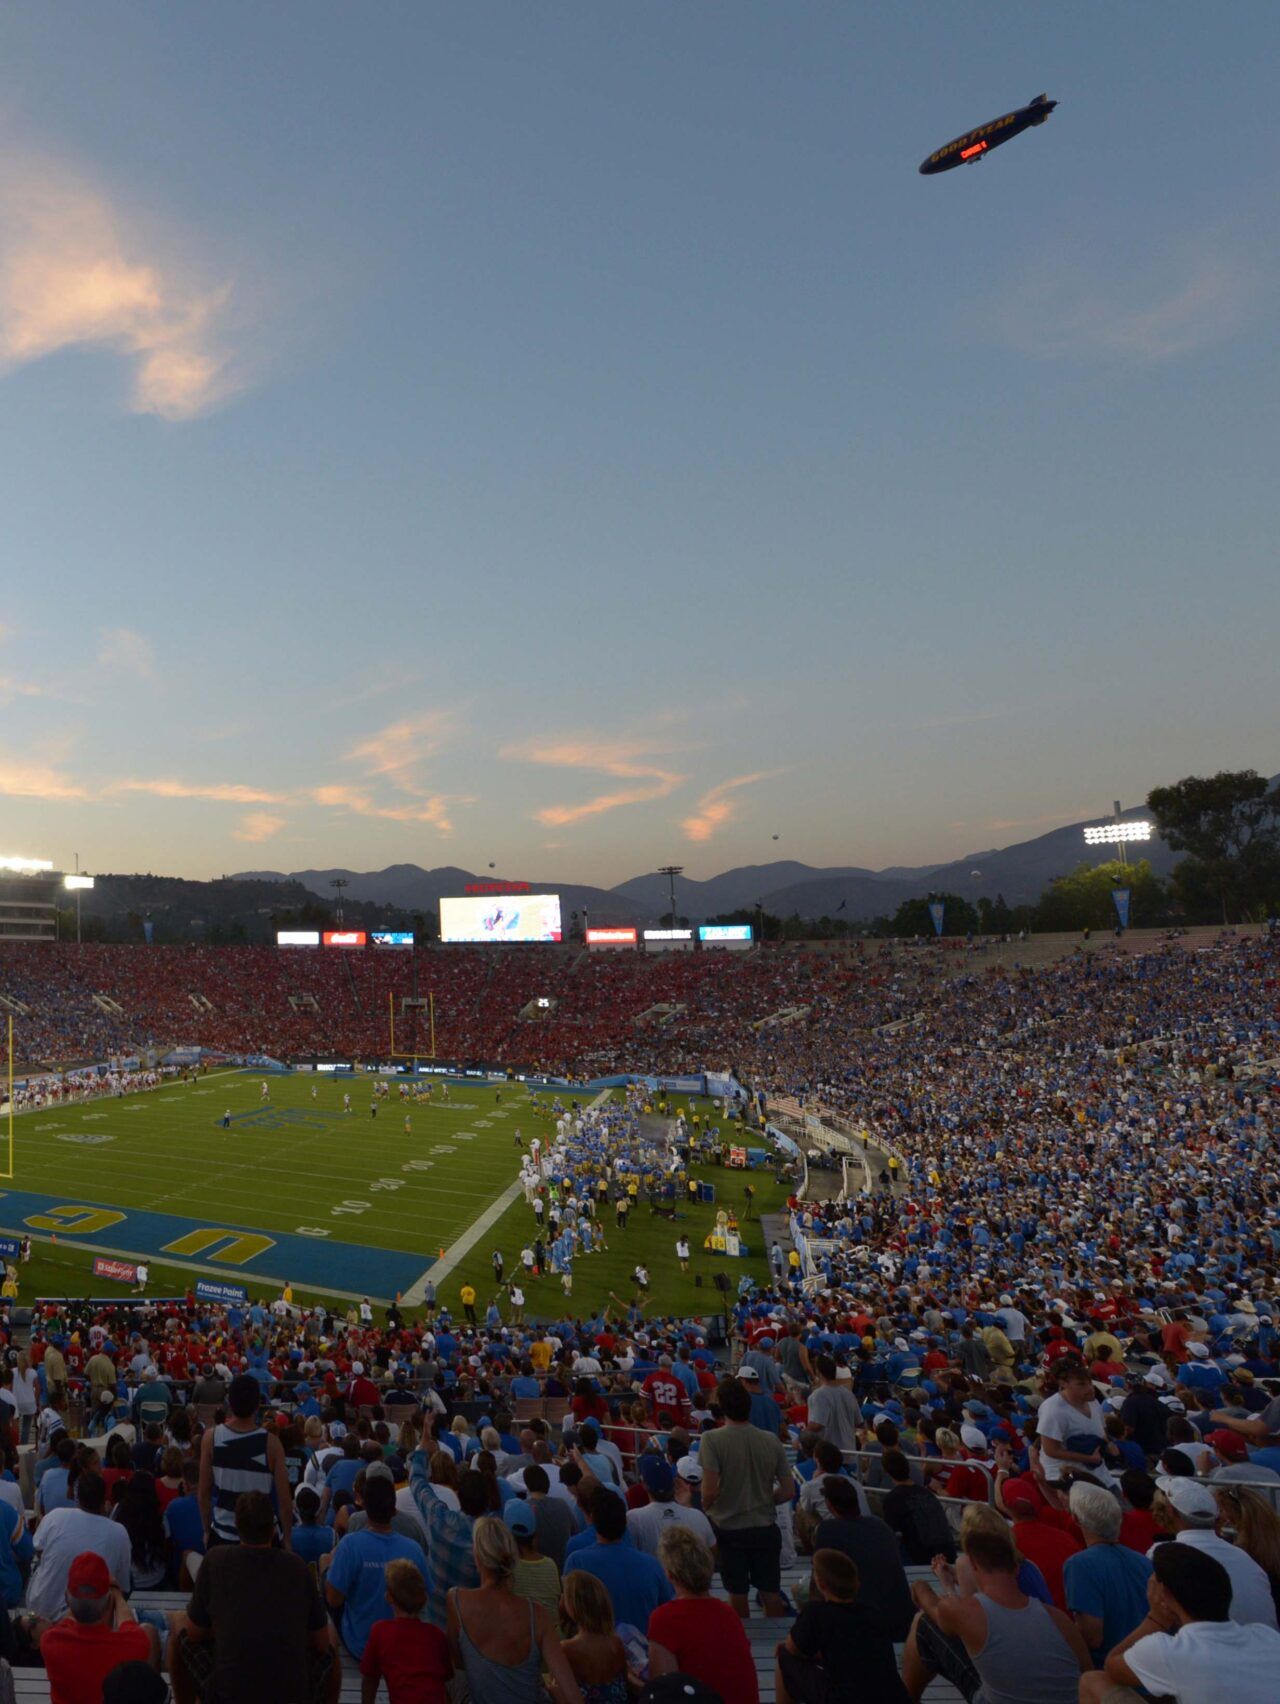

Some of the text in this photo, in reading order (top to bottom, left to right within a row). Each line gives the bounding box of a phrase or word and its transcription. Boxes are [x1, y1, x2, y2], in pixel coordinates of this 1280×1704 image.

[197, 1282, 221, 1293] Frazee
[222, 1285, 244, 1298] Paint
[652, 1381, 677, 1405] 22
